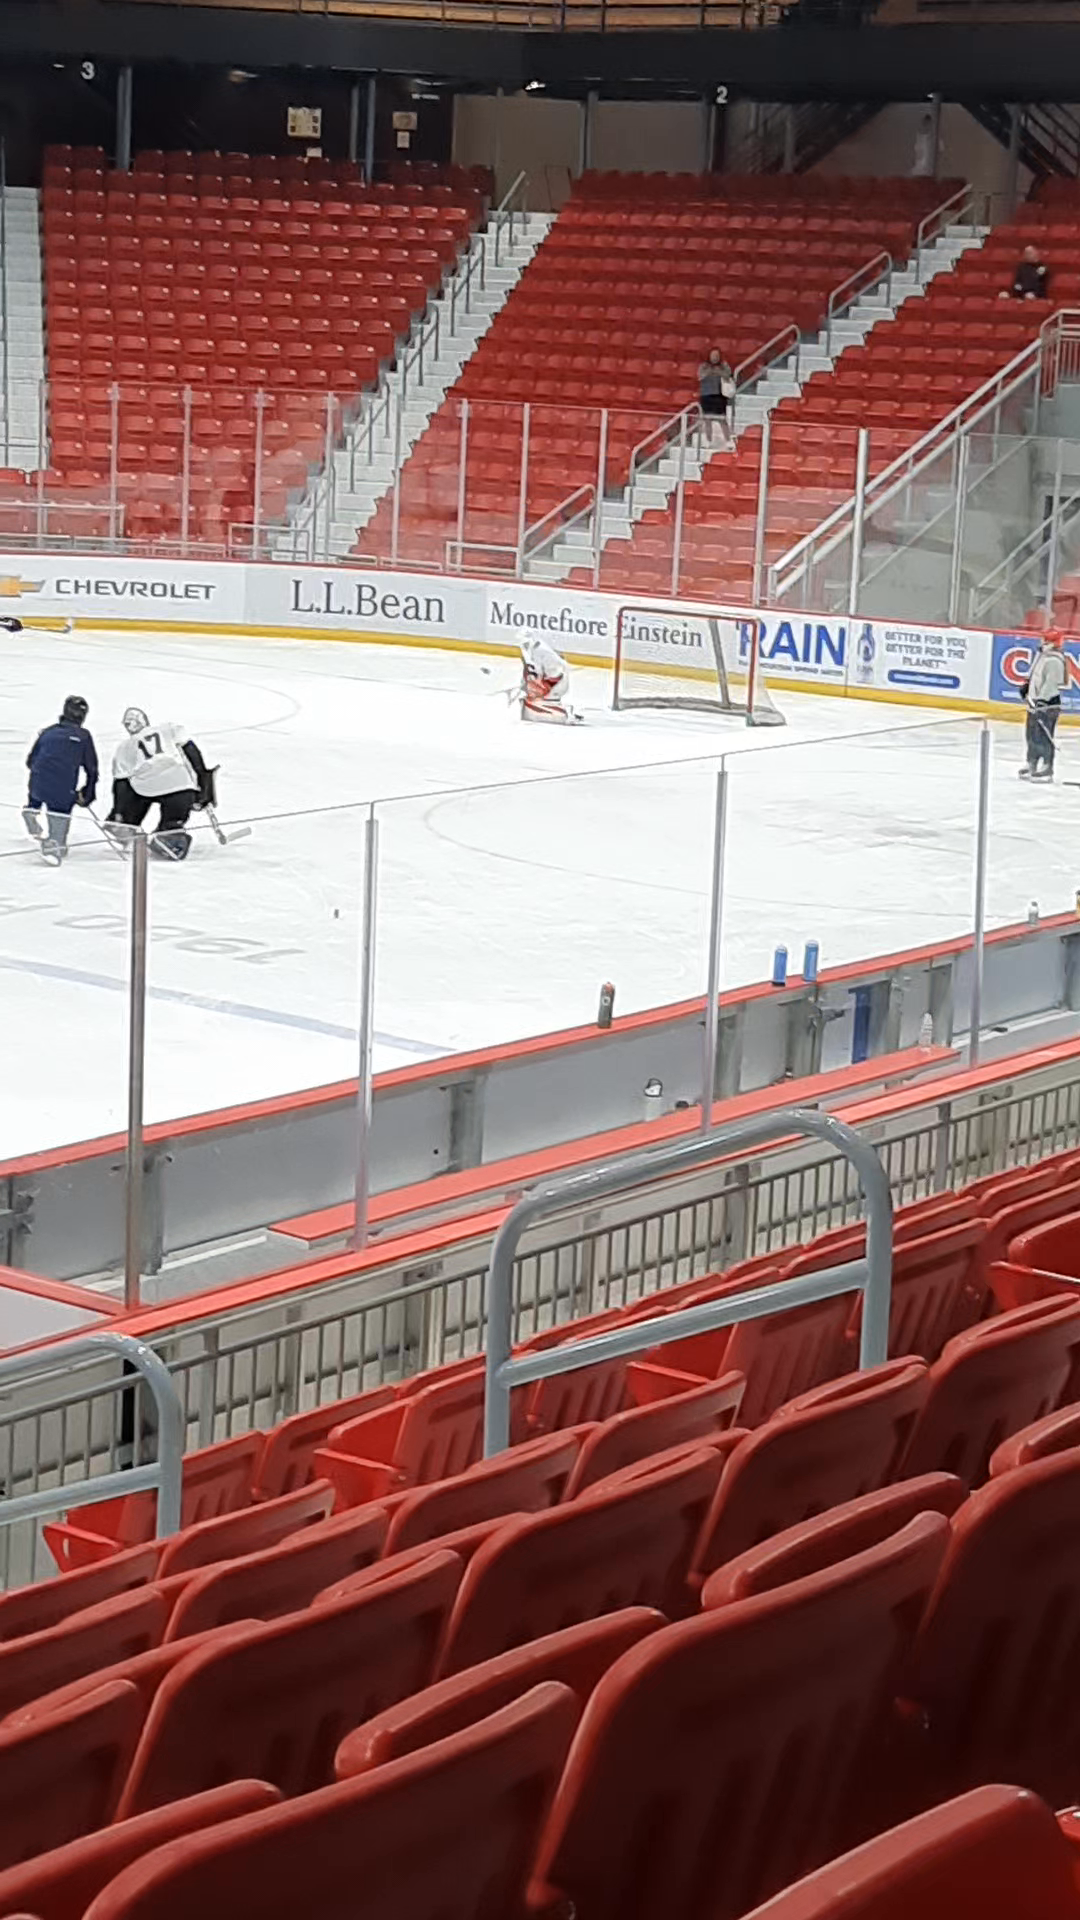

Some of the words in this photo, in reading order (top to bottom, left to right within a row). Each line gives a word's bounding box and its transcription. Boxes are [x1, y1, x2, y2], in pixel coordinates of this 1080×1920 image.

[81, 61, 95, 80] 3
[716, 85, 728, 104] 2
[55, 578, 216, 600] CHEVROLET
[291, 579, 446, 623] L.L.Bean
[490, 601, 608, 637] Montefiore
[738, 619, 846, 667] RAIN
[885, 631, 921, 643] BETTER
[925, 635, 943, 645] FOR
[886, 643, 922, 655] BETTER
[925, 646, 944, 657] FOR
[947, 648, 965, 660] THE
[138, 732, 165, 760] 17
